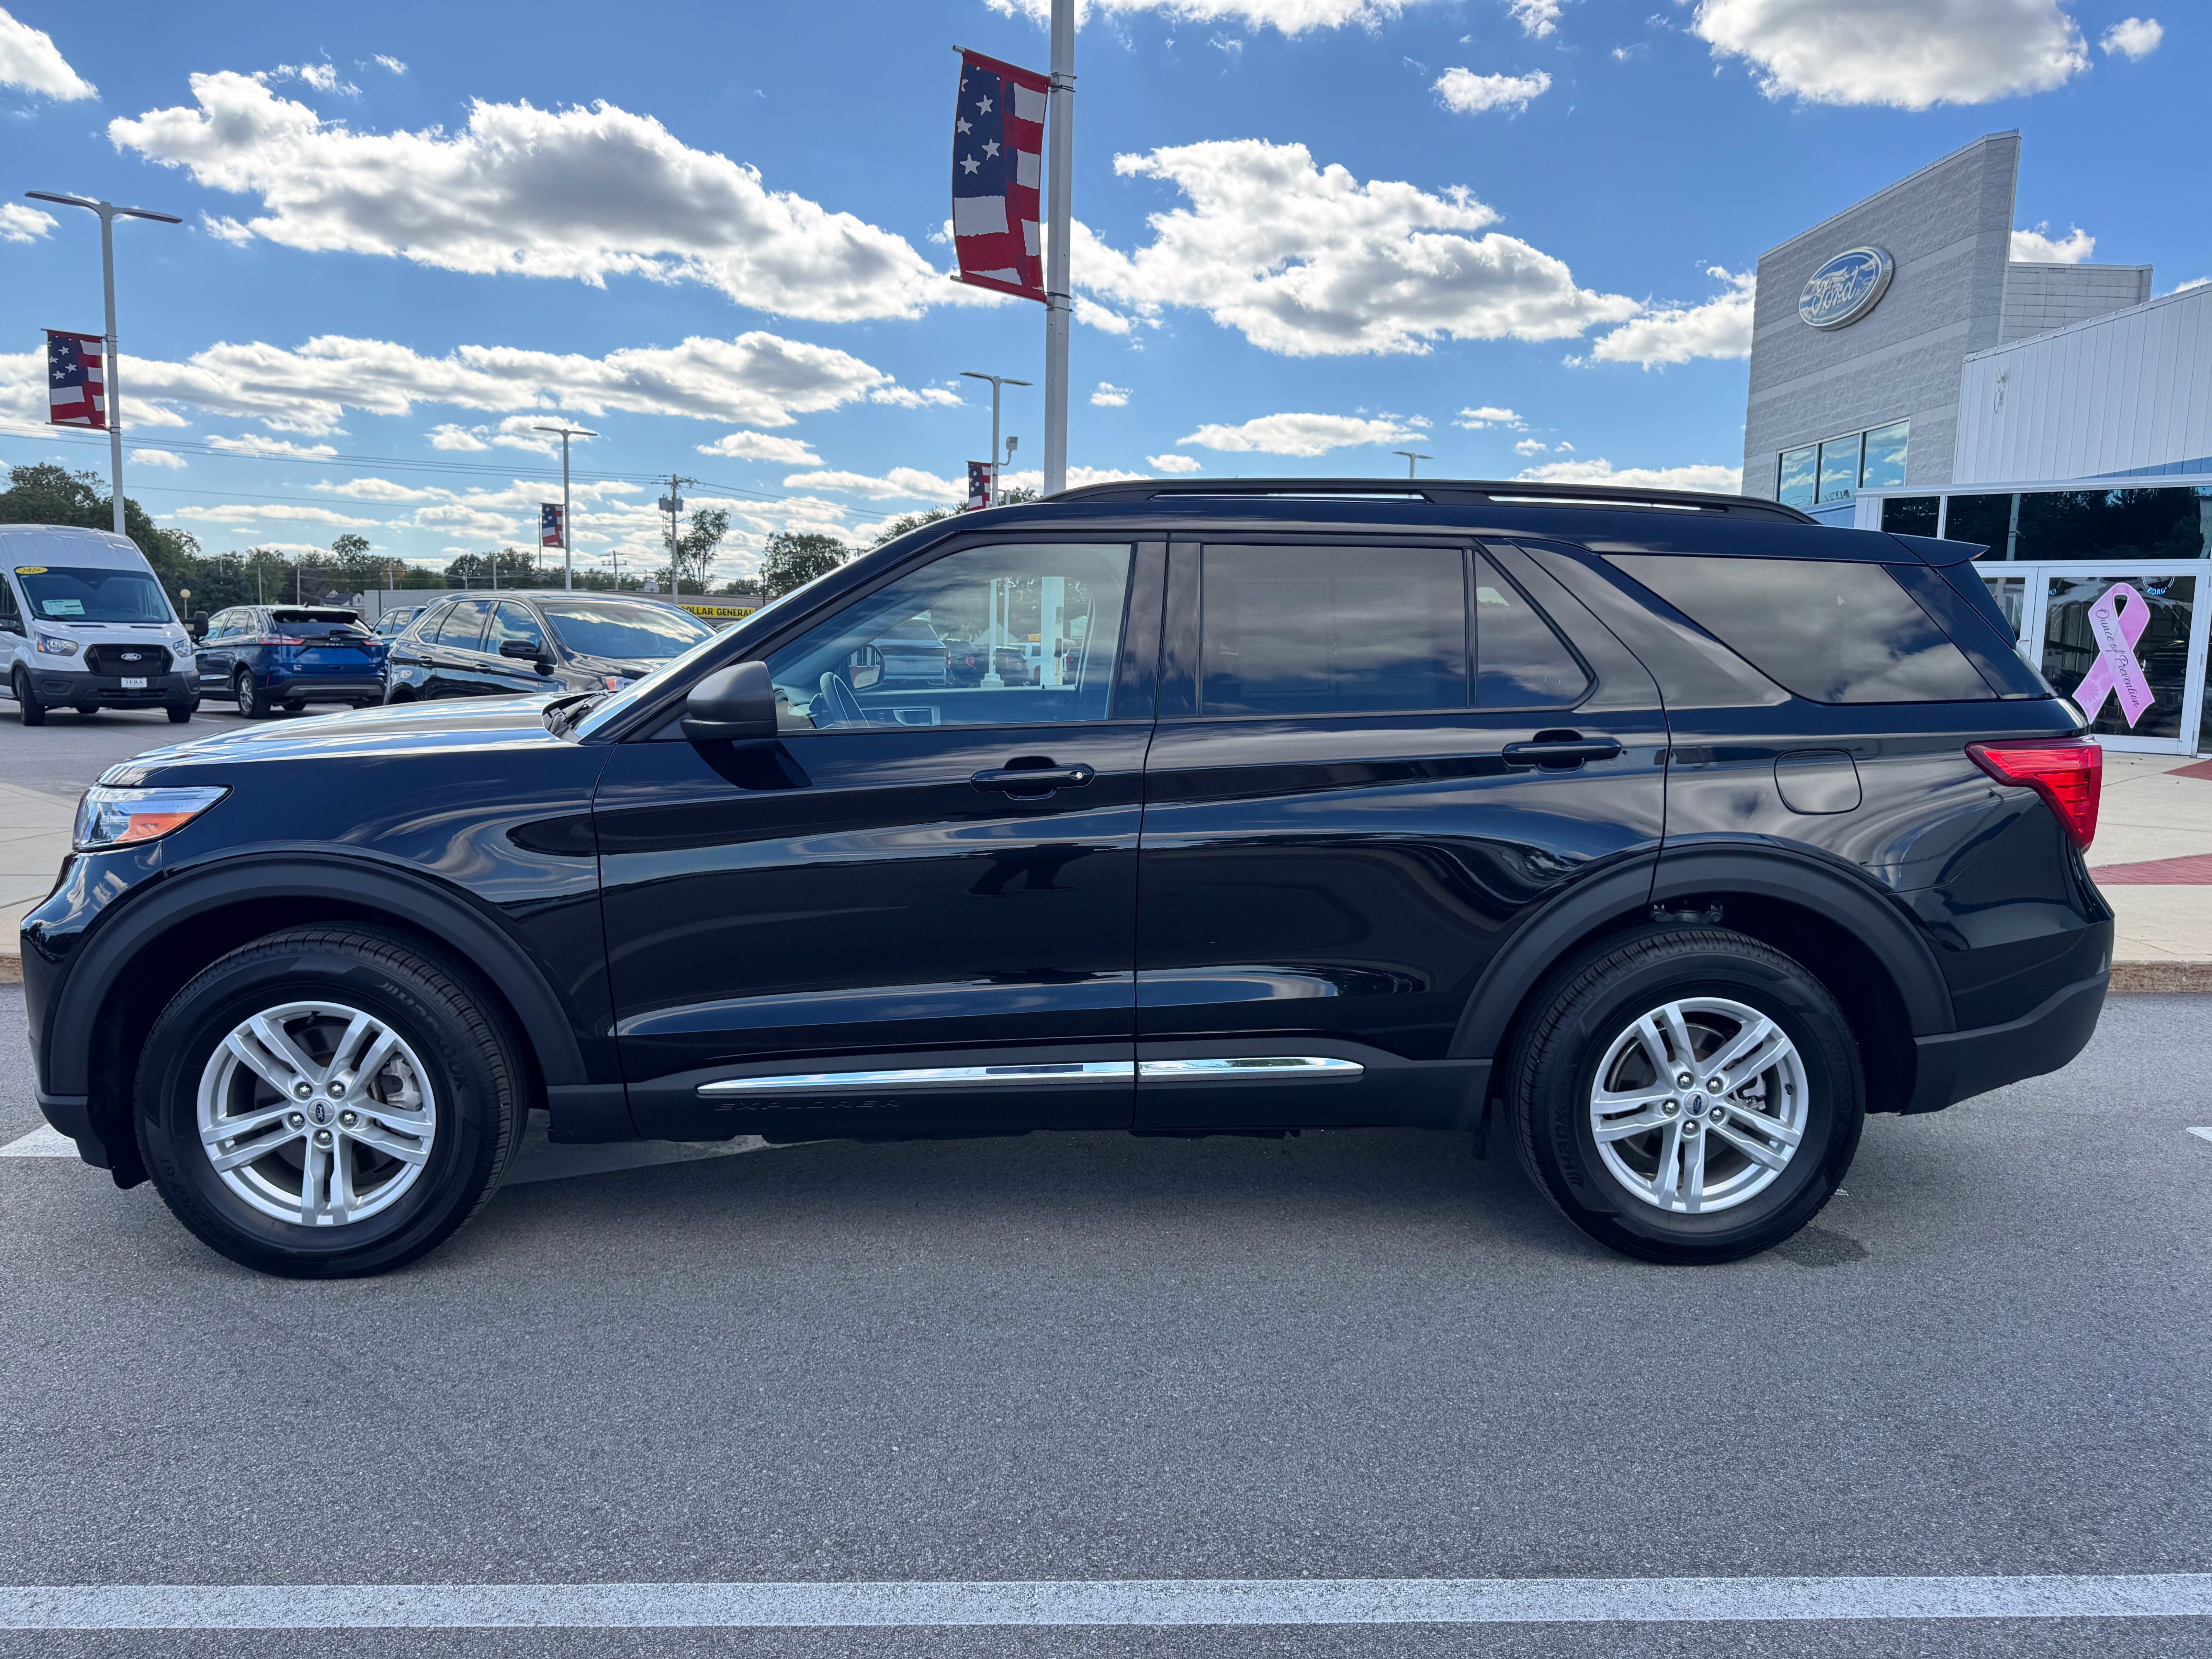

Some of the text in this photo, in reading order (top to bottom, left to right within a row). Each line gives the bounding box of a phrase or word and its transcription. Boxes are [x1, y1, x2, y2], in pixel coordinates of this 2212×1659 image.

[1812, 266, 1859, 316] Ford
[682, 606, 713, 615] OLLAR
[2095, 608, 2139, 708] Ounce of Prevention
